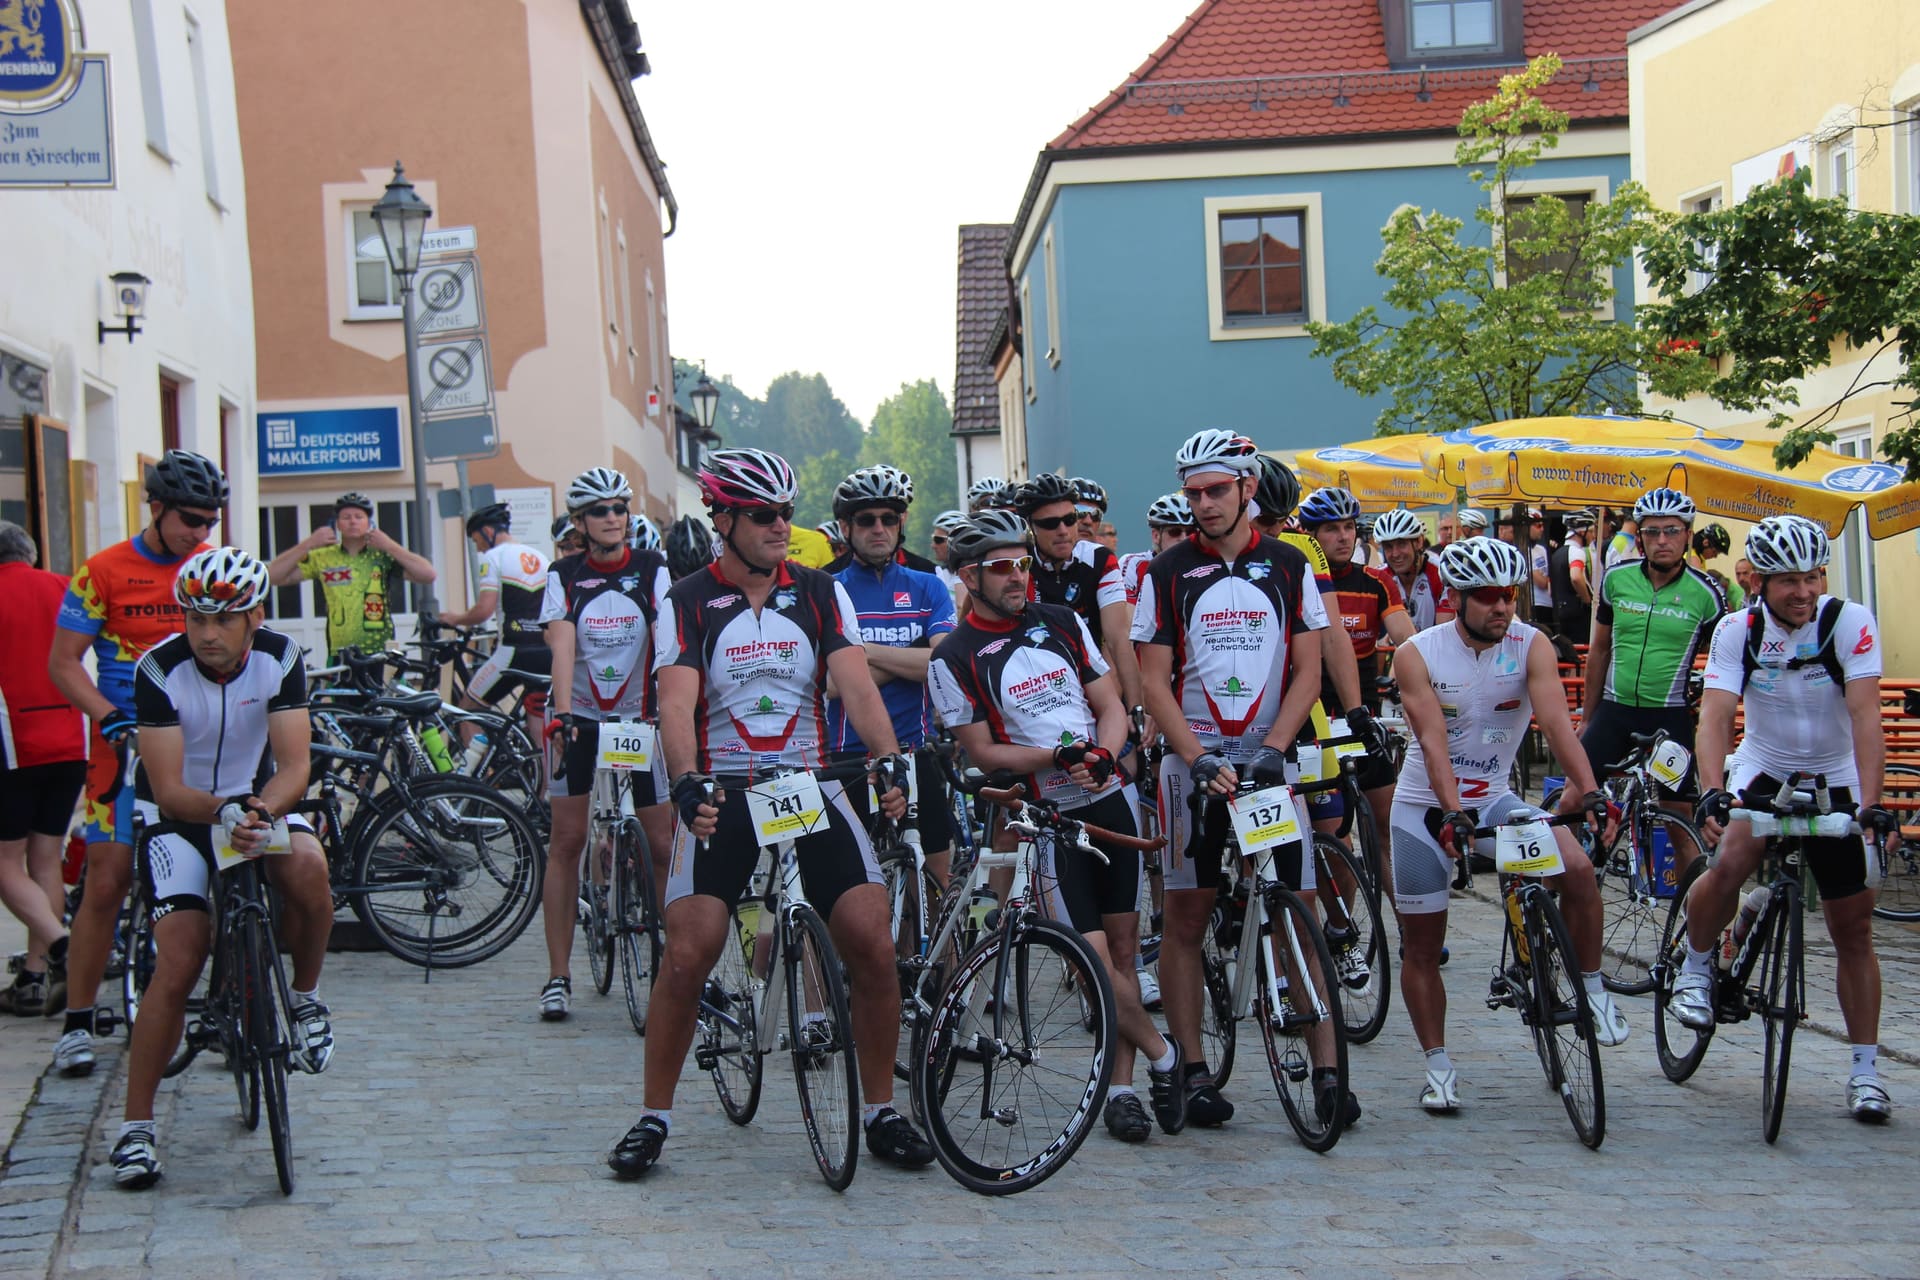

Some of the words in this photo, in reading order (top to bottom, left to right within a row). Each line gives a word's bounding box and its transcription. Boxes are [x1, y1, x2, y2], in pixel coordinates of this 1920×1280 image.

[3, 122, 39, 144] Zum
[421, 237, 461, 250] useum
[430, 314, 463, 330] ZONE
[439, 391, 472, 406] ZONE
[300, 431, 381, 448] DEUTSCHES
[267, 447, 381, 466] MAKLERFORUM
[1531, 463, 1647, 489] www.rhaner.de
[1745, 484, 1797, 509] Älteste
[585, 615, 639, 625] meixner
[1200, 608, 1268, 622] meixner
[1205, 634, 1246, 646] Neunburg
[1211, 642, 1261, 652] Schwandorf
[725, 640, 799, 658] meixner
[732, 666, 778, 681] Neunburg
[1008, 667, 1068, 696] meixner
[612, 736, 641, 752] 140
[1666, 756, 1676, 768] 6
[768, 793, 803, 818] 141
[1248, 804, 1282, 828] 137
[1517, 841, 1541, 860] 16
[1013, 1049, 1103, 1176] VUELTA
